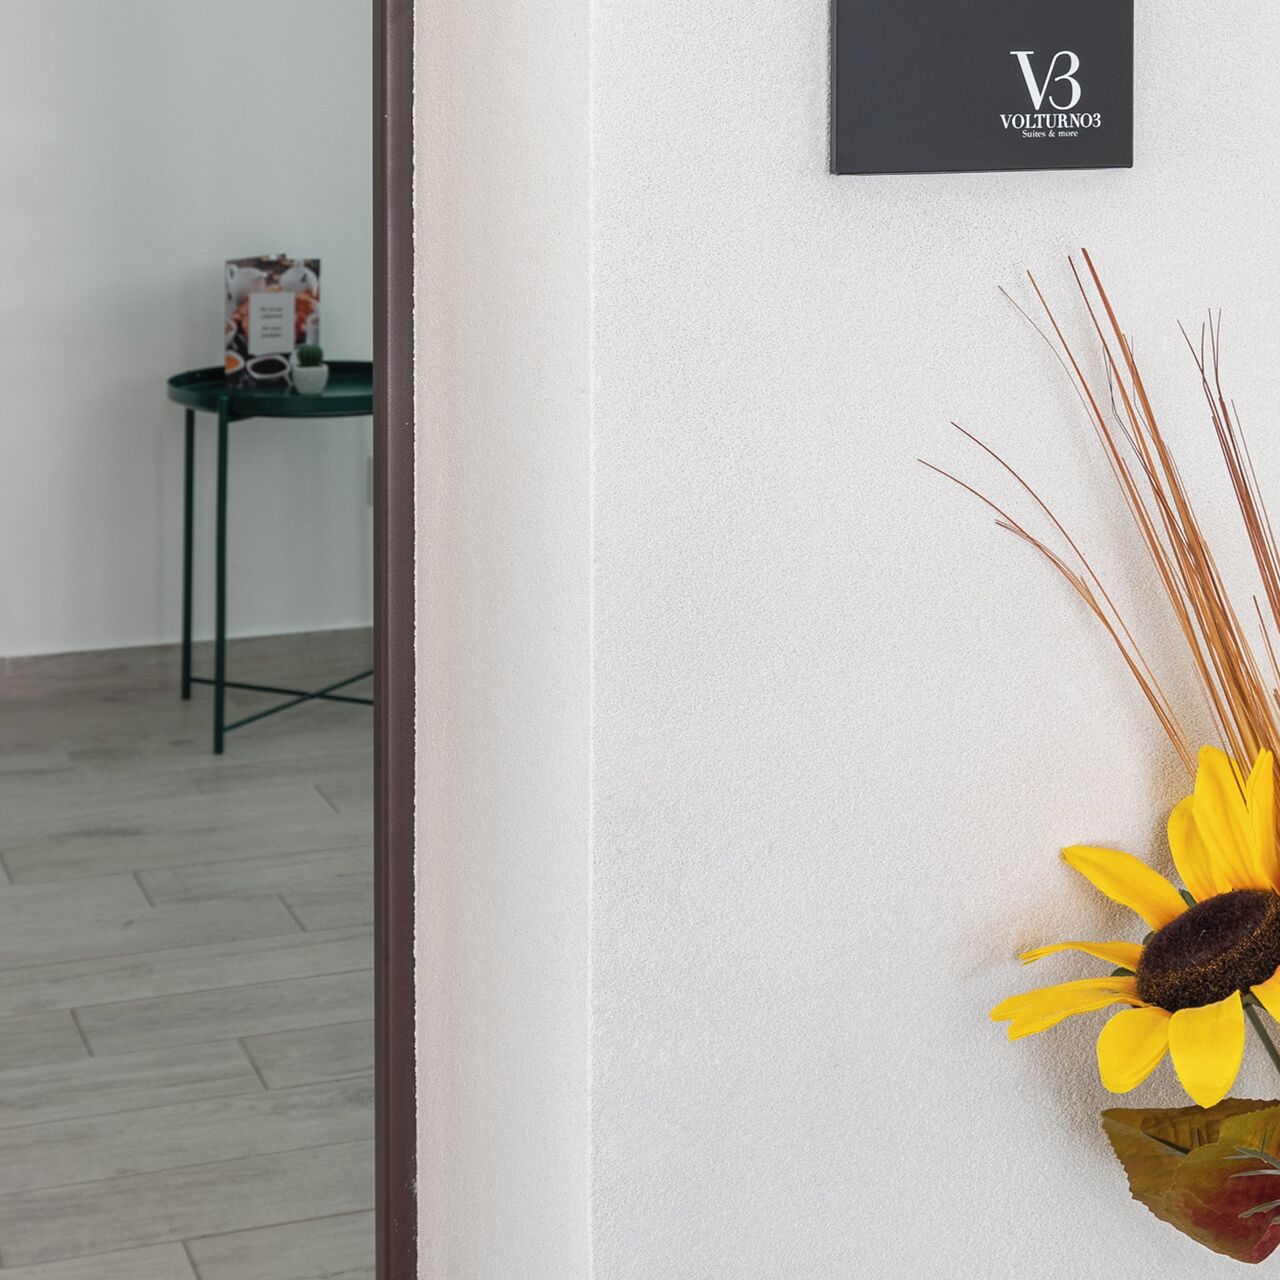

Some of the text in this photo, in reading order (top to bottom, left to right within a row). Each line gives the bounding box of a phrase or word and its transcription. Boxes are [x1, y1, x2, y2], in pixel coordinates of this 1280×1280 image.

[1009, 50, 1082, 111] V3
[999, 112, 1102, 129] VOLTURNO3
[1022, 129, 1079, 138] Suites & more
